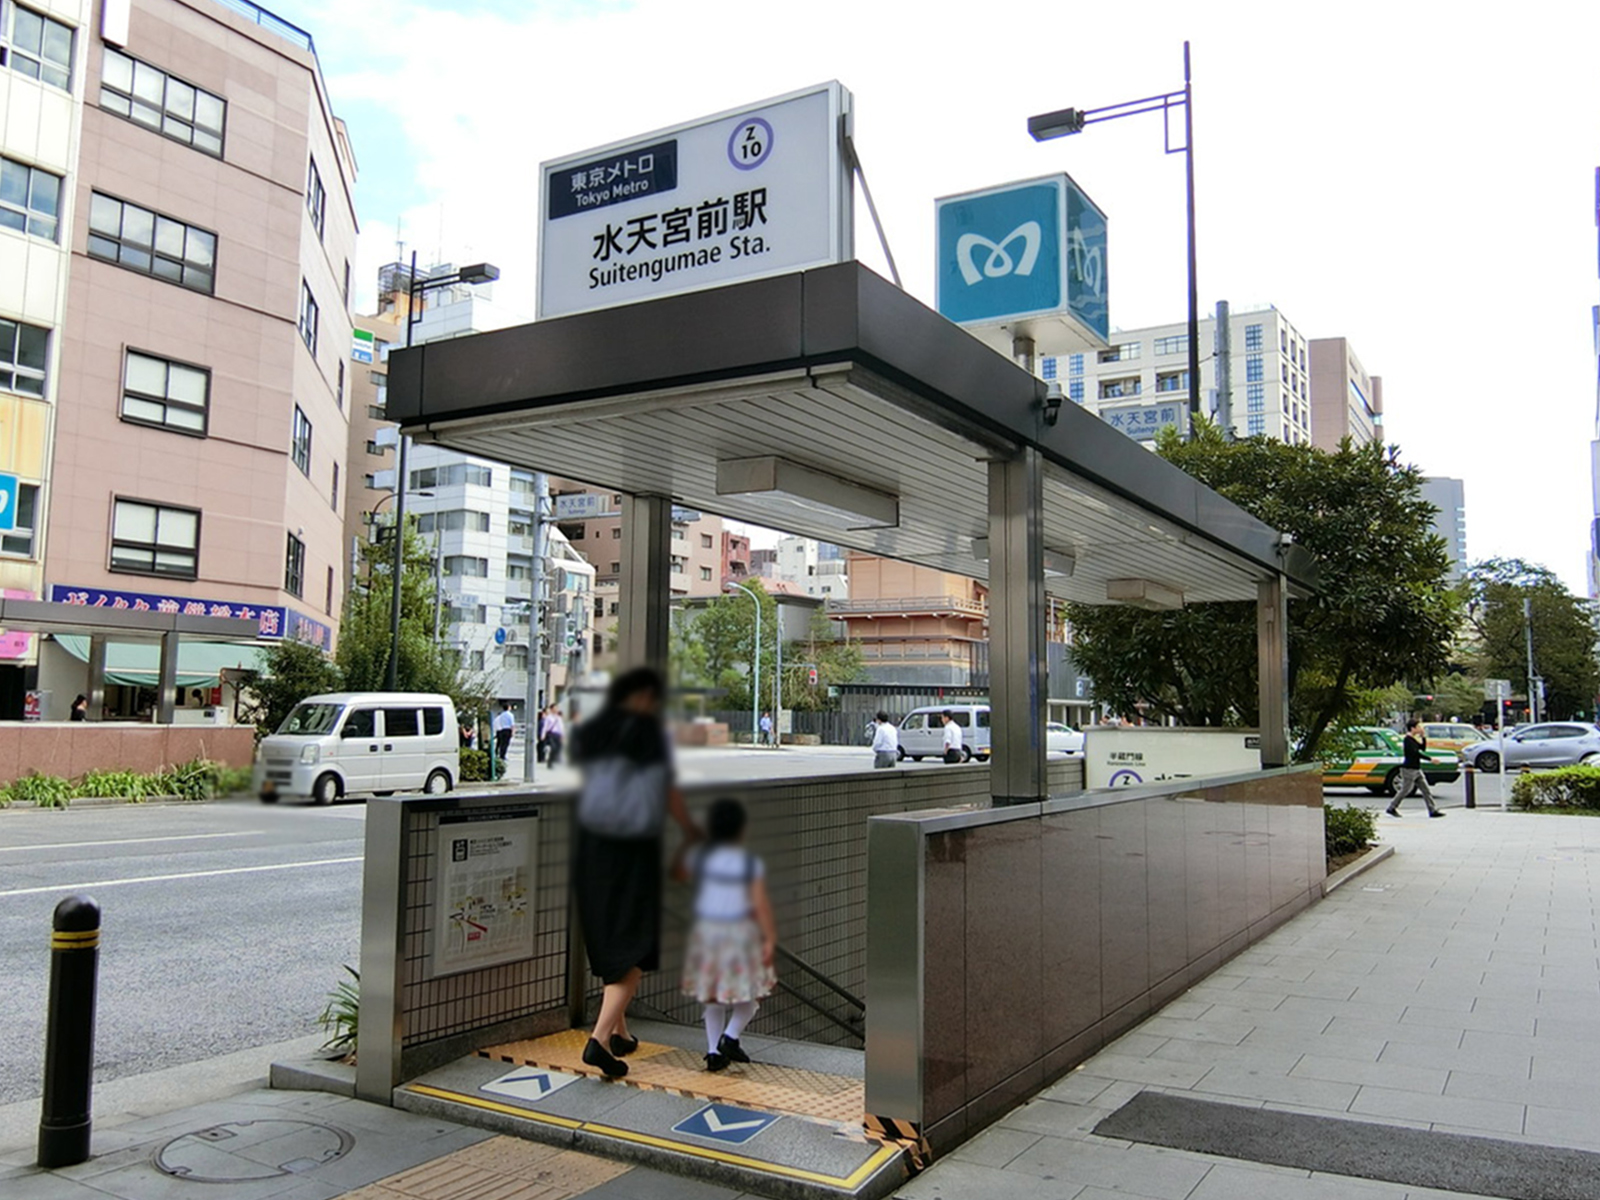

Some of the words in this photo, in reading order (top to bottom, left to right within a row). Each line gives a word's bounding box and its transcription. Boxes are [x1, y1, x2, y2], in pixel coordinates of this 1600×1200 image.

[745, 126, 756, 142] Z
[742, 141, 762, 159] 10
[570, 154, 654, 193] 東京メトロ
[575, 188, 610, 208] Tokyo
[613, 178, 649, 198] Metro
[592, 187, 768, 262] 水天宮前駅
[588, 246, 722, 289] Suitengumae
[730, 233, 771, 260] Sta.
[1110, 407, 1175, 426] 水天宮前
[1123, 776, 1130, 785] Z
